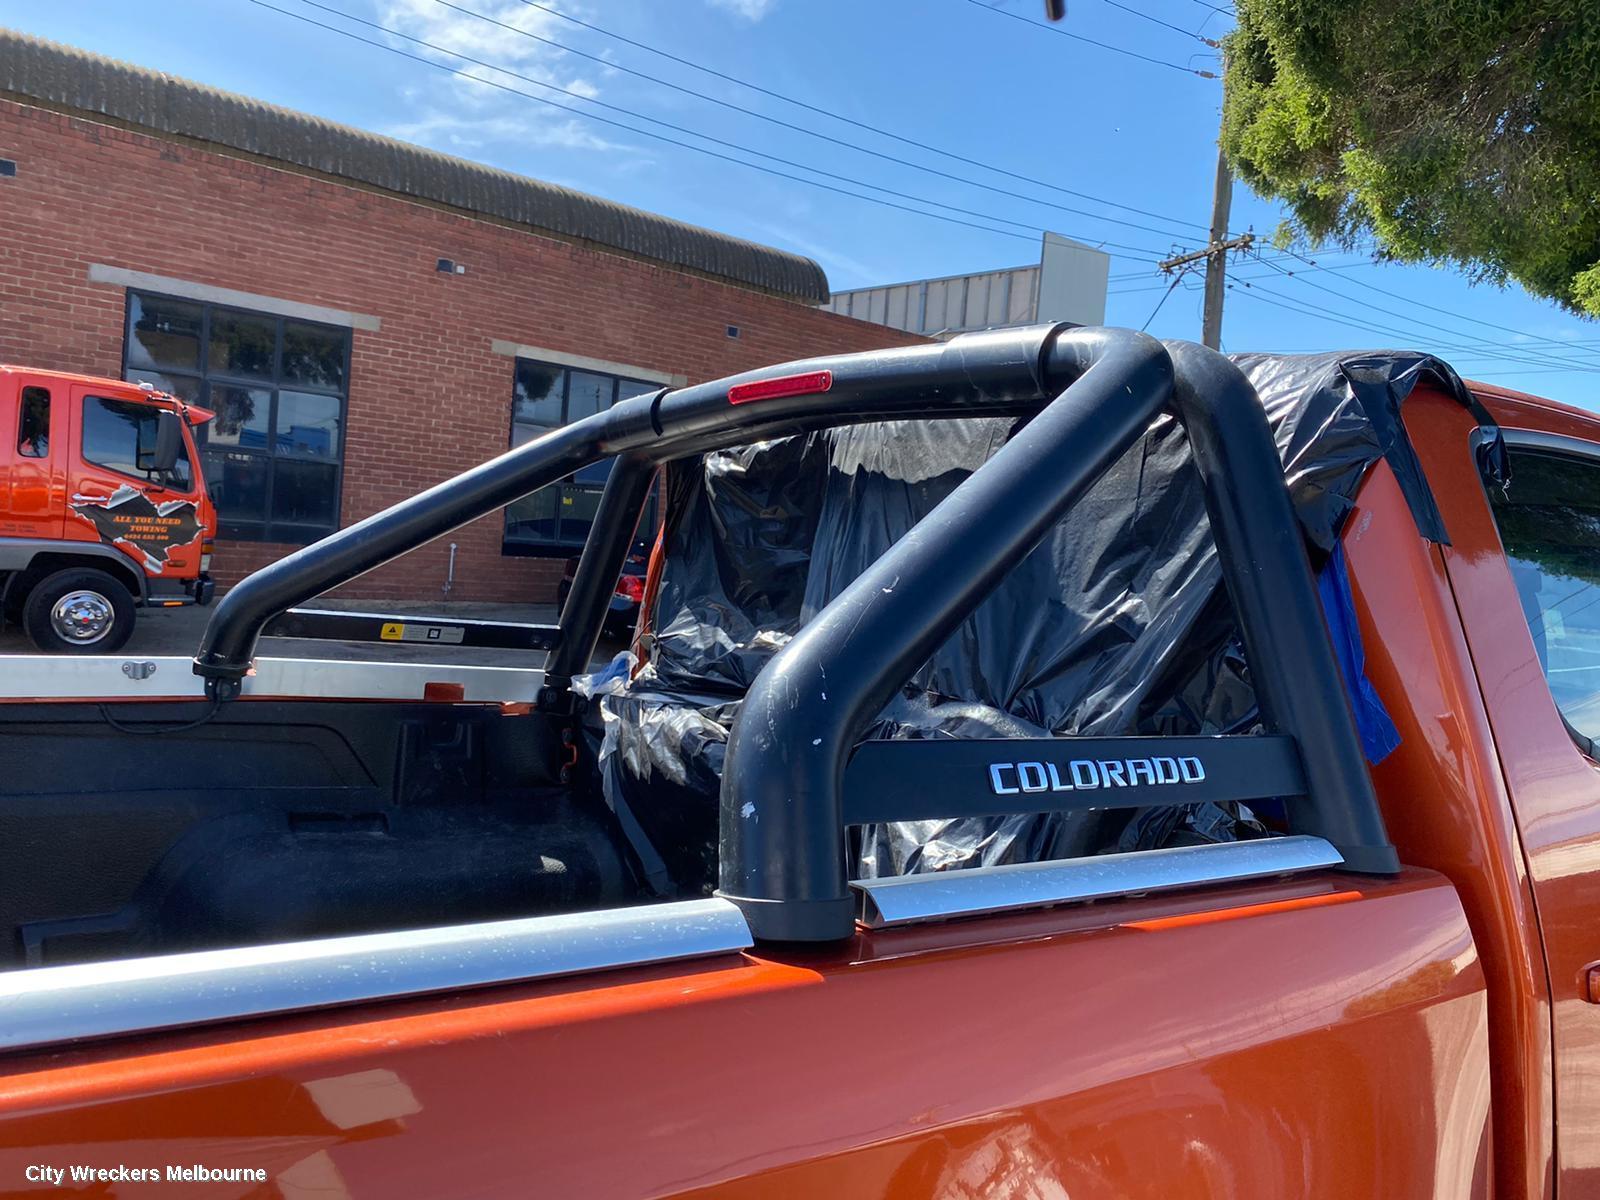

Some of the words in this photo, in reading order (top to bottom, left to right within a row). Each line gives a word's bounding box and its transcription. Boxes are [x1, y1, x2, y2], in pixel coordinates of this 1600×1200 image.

[113, 515, 132, 523] ALL
[134, 516, 153, 524] YOU
[155, 517, 182, 526] NEED
[129, 525, 168, 533] TOWING
[990, 756, 1206, 794] COLORADO
